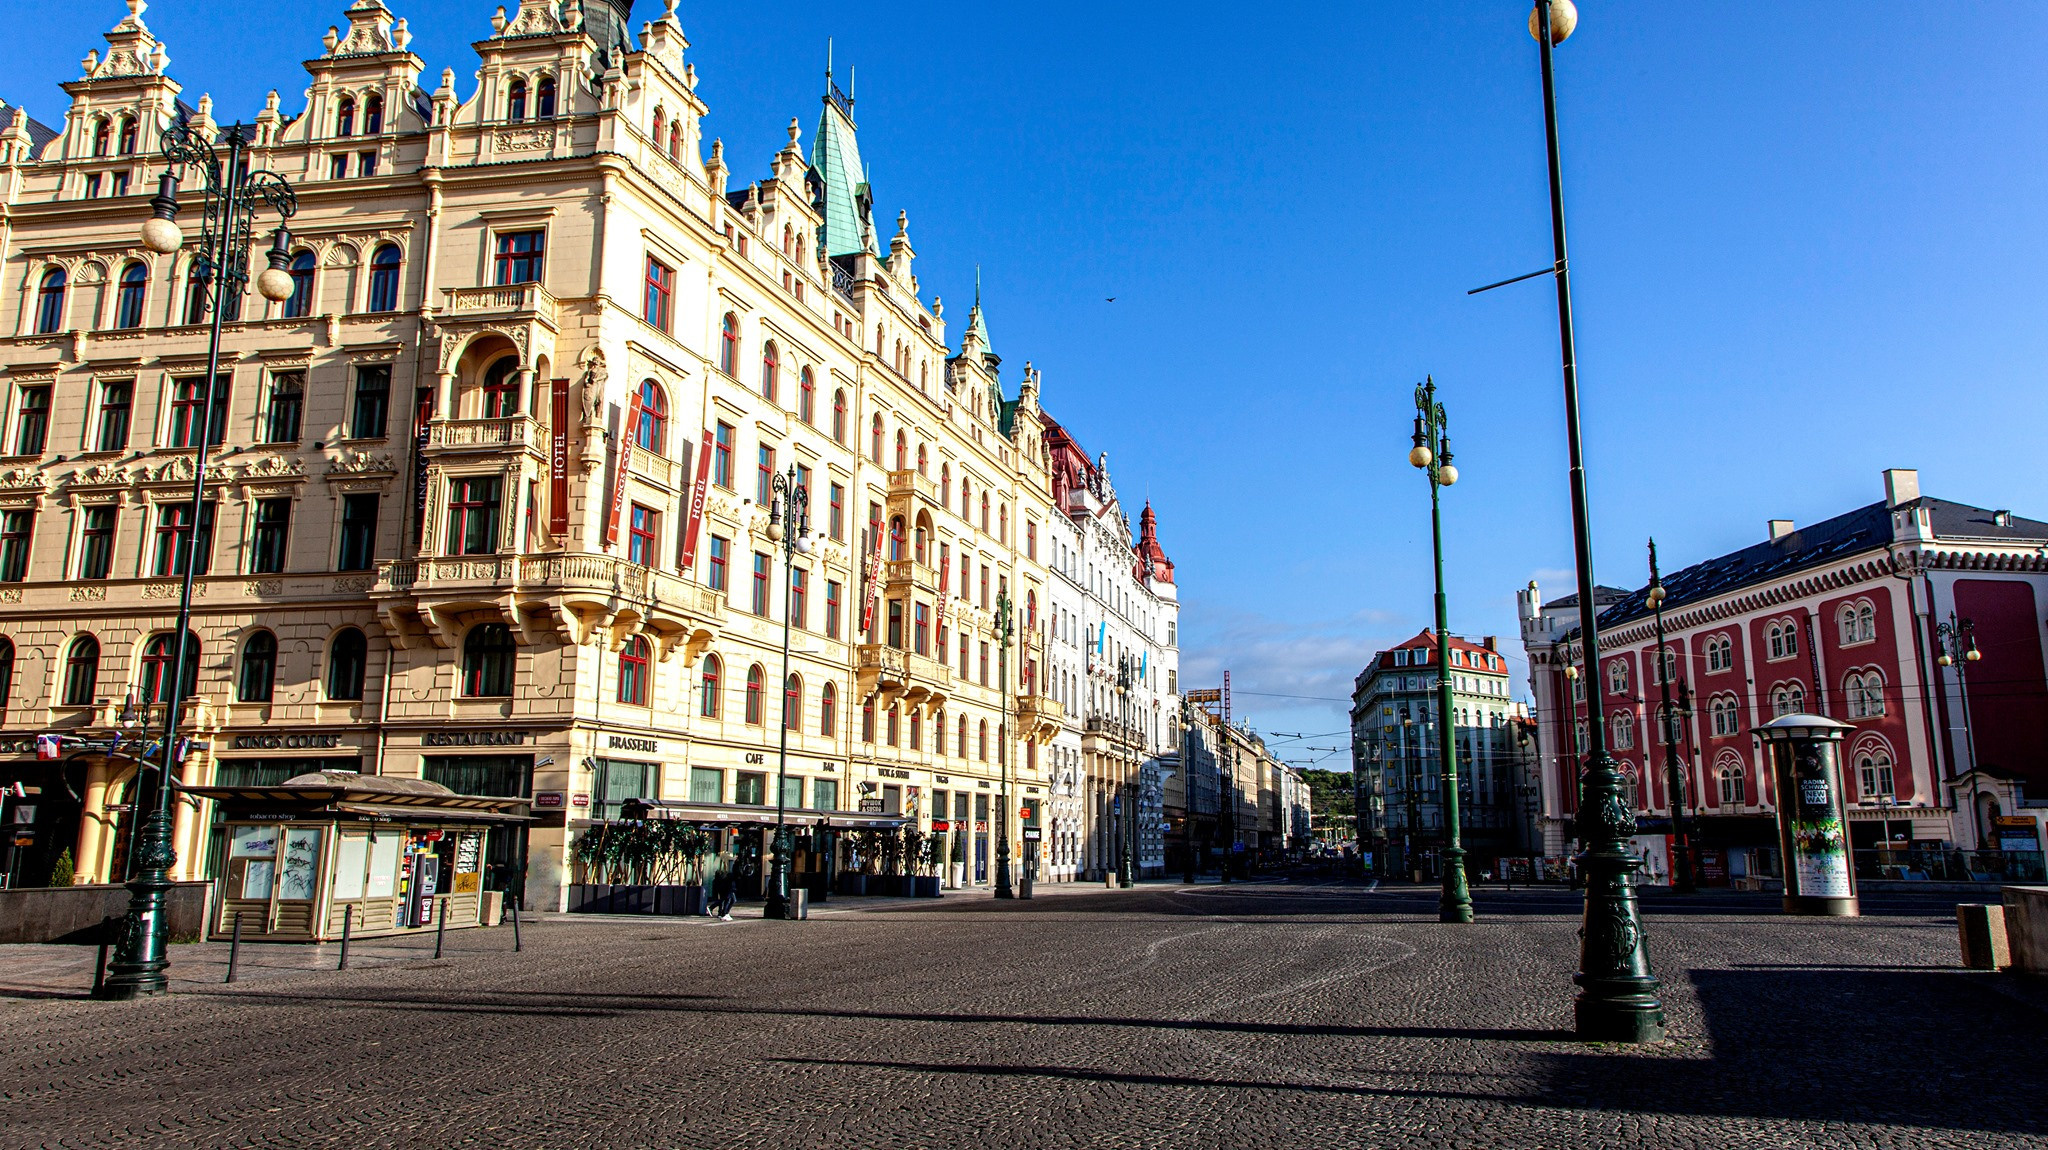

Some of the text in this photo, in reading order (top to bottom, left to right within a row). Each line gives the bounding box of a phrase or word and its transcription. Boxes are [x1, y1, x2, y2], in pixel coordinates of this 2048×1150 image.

[554, 432, 565, 480] HOTEL
[614, 428, 634, 512] KINGS COURT
[691, 478, 706, 520] HOTEL
[867, 549, 881, 608] KINGS COURT
[938, 591, 946, 619] HOTEL
[235, 734, 343, 749] KINGS COURT
[427, 732, 530, 746] RESTAURANT
[609, 736, 658, 752] BRASSERIE
[1384, 707, 1396, 788] HOTEL
[745, 752, 764, 765] CAFE
[822, 762, 835, 772] BAR
[878, 768, 890, 777] WOK
